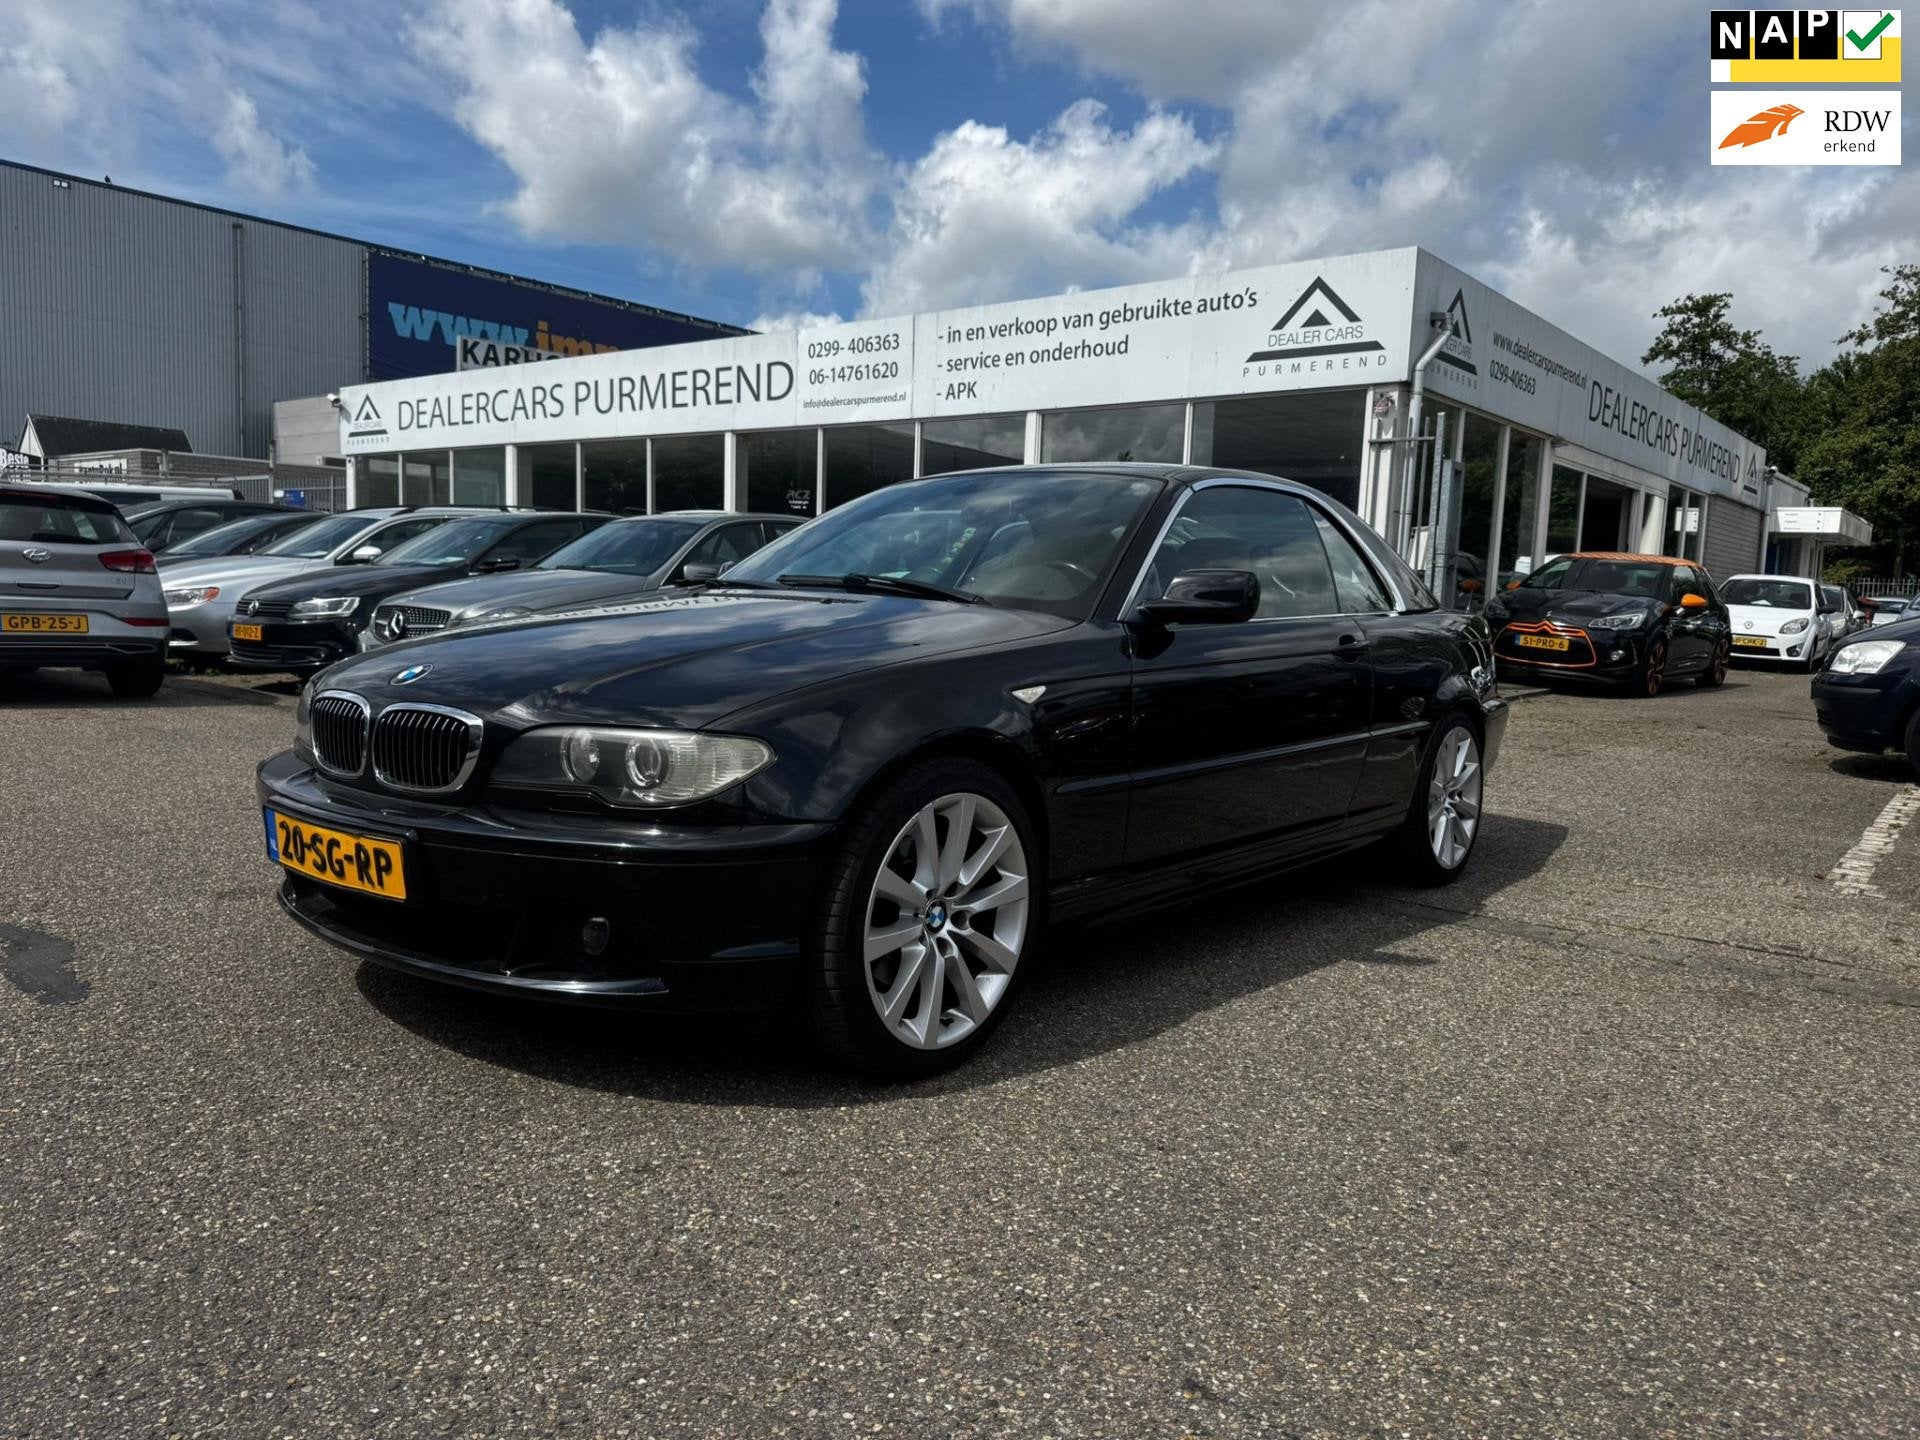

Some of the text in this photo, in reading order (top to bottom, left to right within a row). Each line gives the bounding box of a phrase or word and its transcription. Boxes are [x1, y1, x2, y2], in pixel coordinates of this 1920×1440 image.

[947, 326, 962, 344] in
[966, 326, 985, 341] en
[989, 316, 1058, 337] verkoop
[1063, 312, 1094, 330] van
[1099, 297, 1193, 331] gebruikte
[1197, 286, 1258, 314] auto's
[847, 333, 900, 354] 406363
[1267, 325, 1364, 347] DEALER CARS
[946, 351, 1001, 373] service
[1005, 351, 1025, 367] en
[1030, 334, 1130, 364] onderhoud
[1242, 354, 1388, 378] PURMEREND
[1493, 330, 1588, 390] www.dealercarspurmerend.nl
[809, 361, 899, 385] 06-14761620
[1489, 359, 1536, 395] 0299-406363
[398, 361, 795, 431] DEALERCARS PURMEREND
[803, 391, 907, 409] info@dealercarspurmerend.nl
[945, 380, 978, 401] APK
[1588, 380, 1741, 483] DEALERCARS PURMEREND
[8, 615, 82, 630] GPB-25-J
[279, 820, 393, 889] 20-SG-RP
